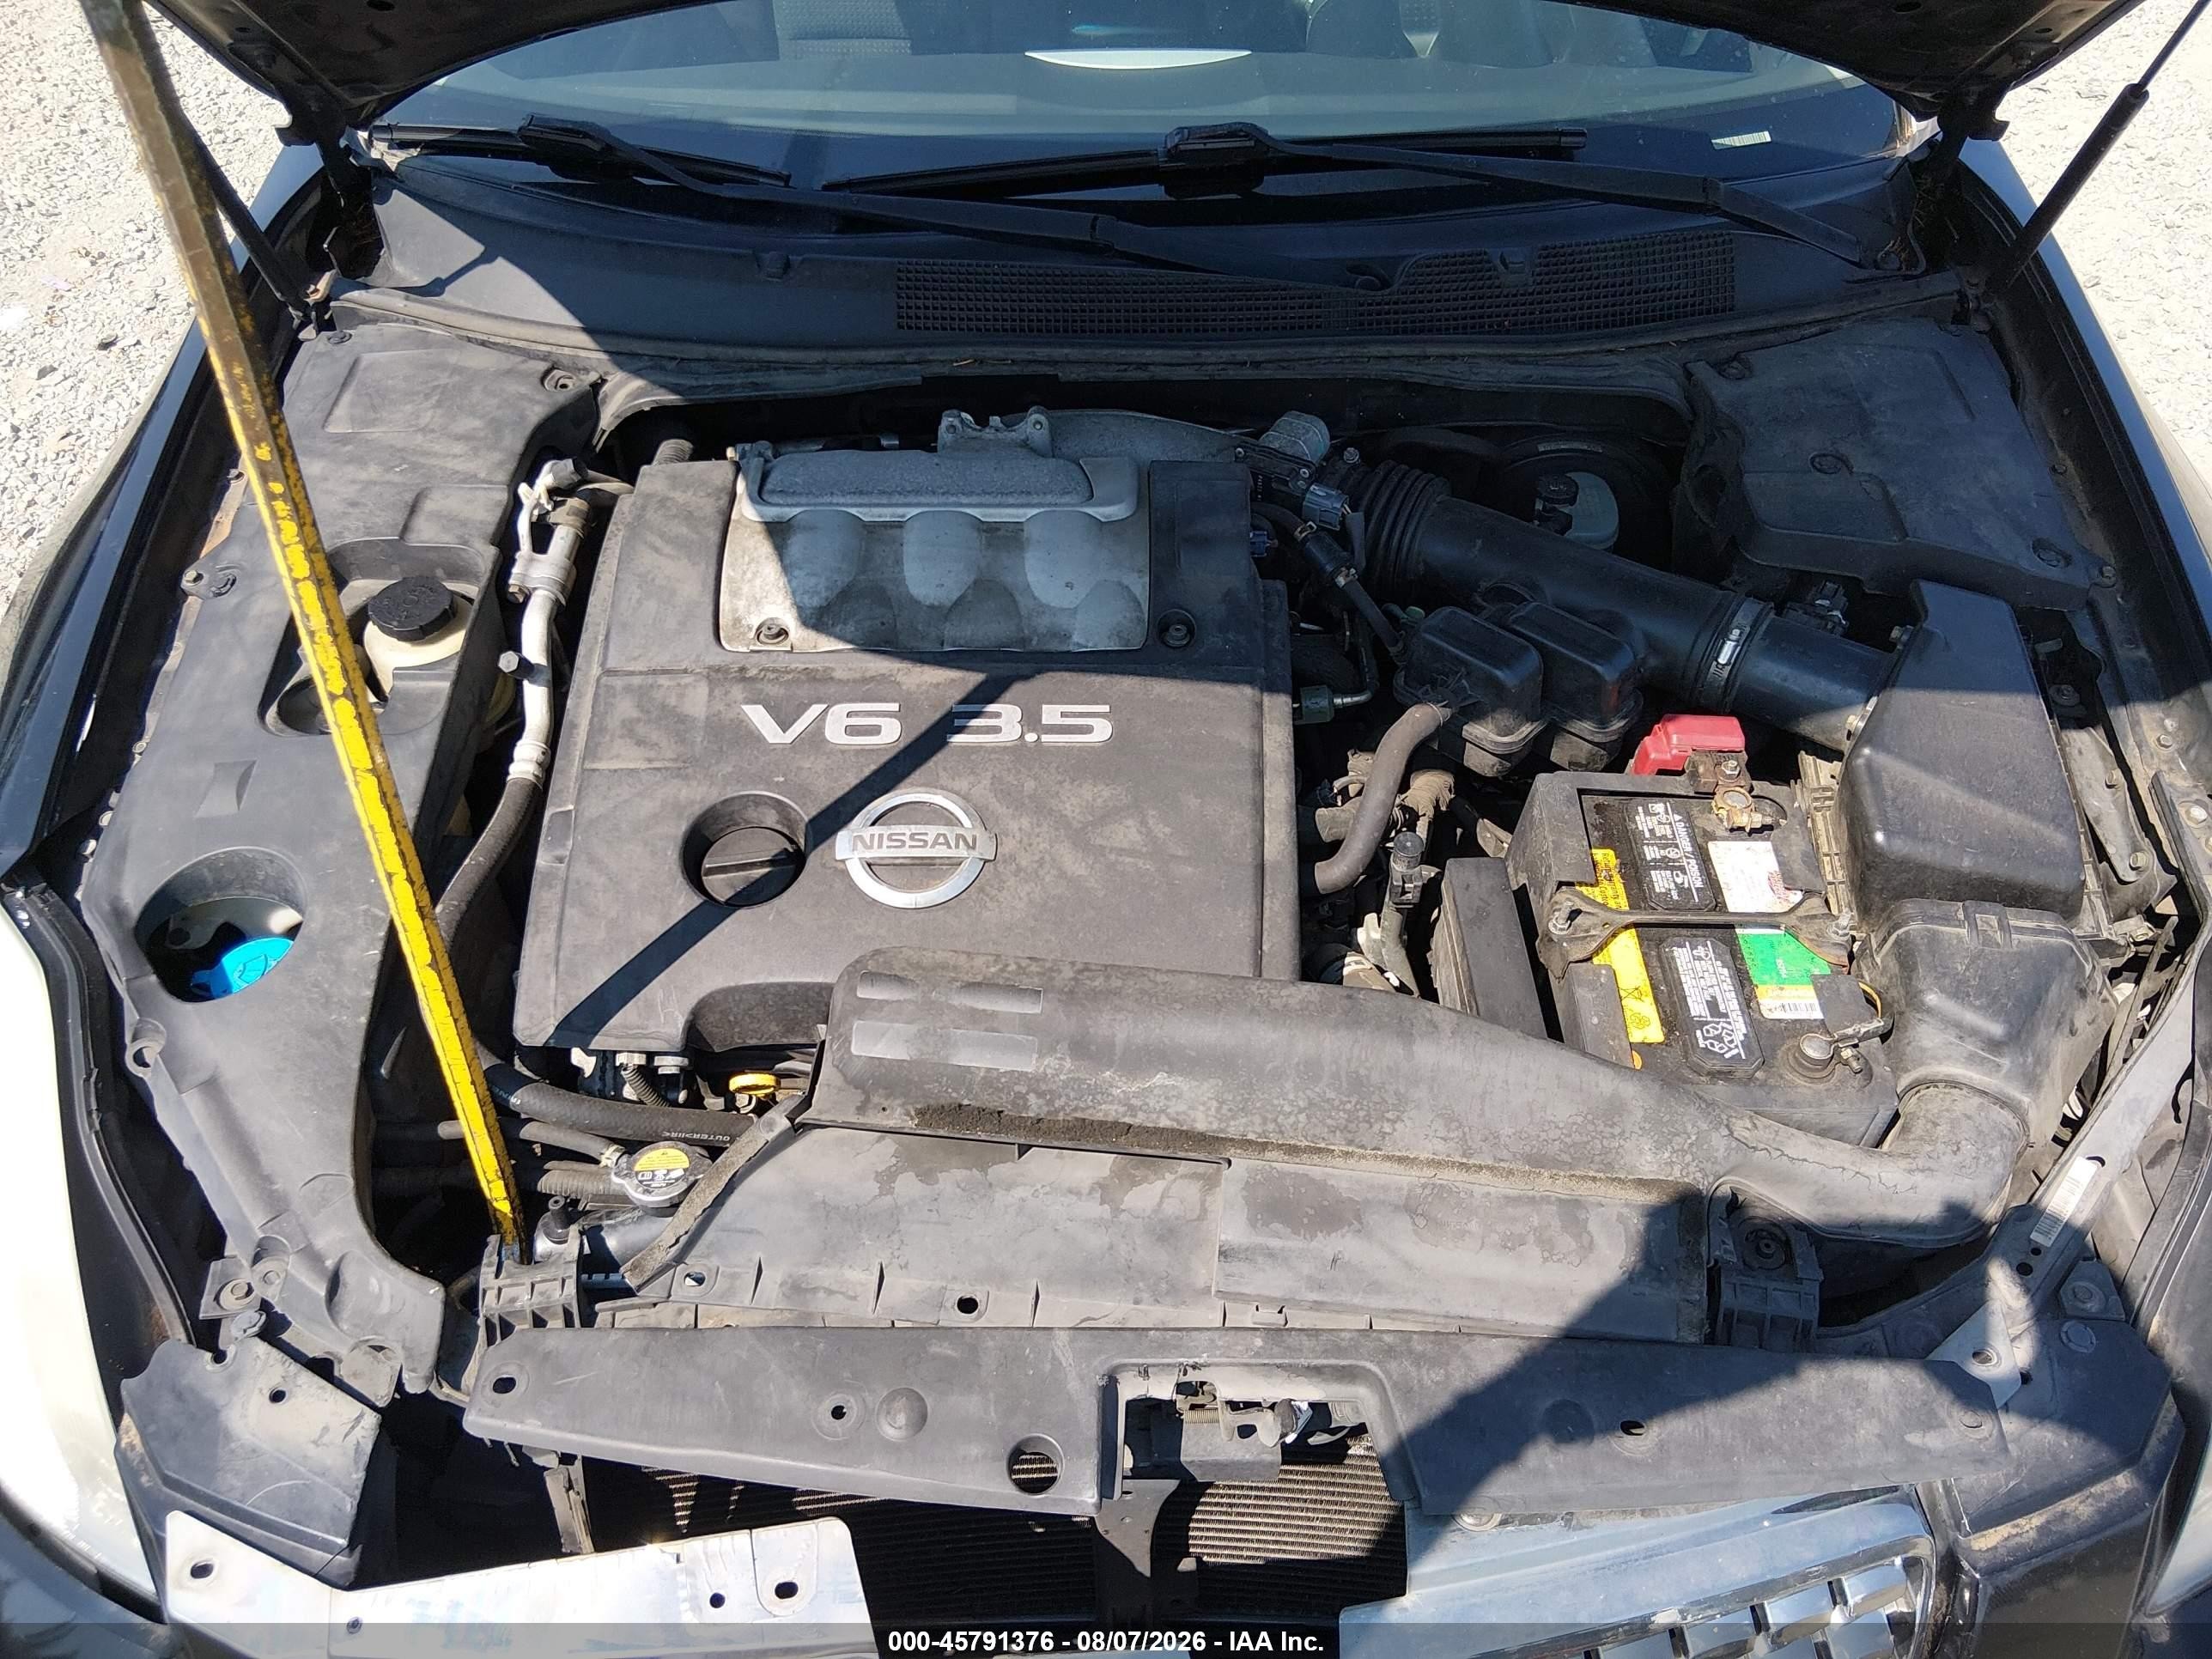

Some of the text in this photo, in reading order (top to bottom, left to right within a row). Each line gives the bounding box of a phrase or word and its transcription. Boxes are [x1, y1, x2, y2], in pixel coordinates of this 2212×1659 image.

[741, 702, 1113, 745] V6 3.5
[852, 831, 977, 850] NISSAN
[1675, 822, 1692, 852] DANGER
[1686, 859, 1705, 888] POISON
